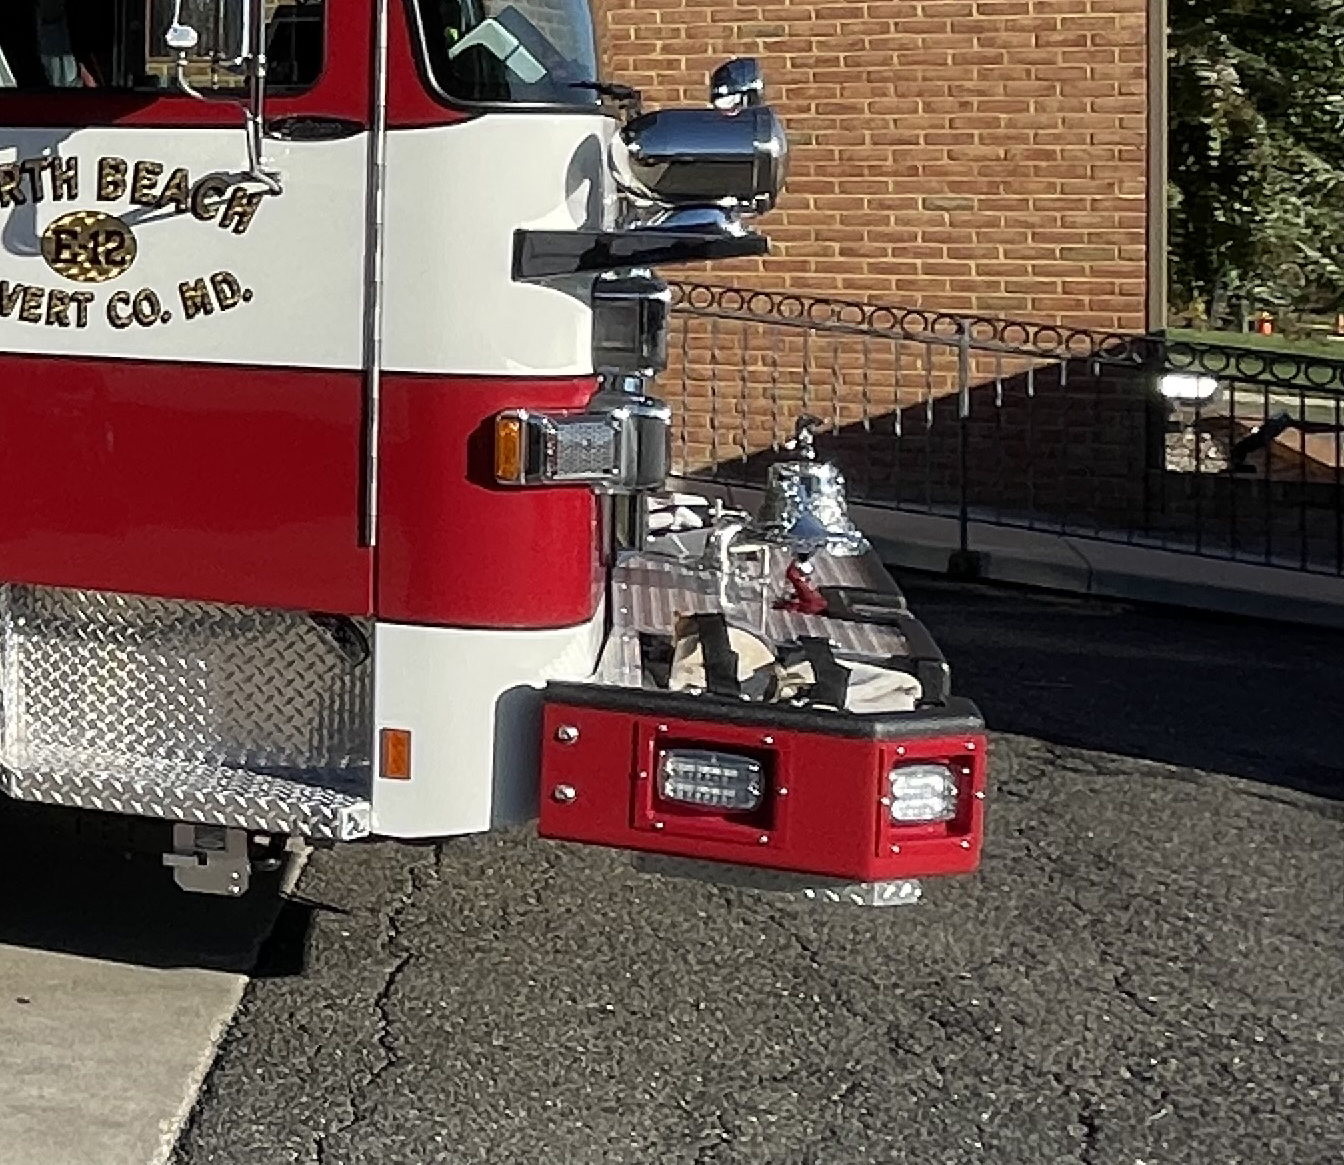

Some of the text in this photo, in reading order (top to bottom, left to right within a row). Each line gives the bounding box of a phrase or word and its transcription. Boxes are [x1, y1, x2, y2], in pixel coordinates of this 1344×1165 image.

[96, 156, 264, 234] BEACH
[107, 289, 171, 329] CO.
[178, 270, 253, 320] MD.
